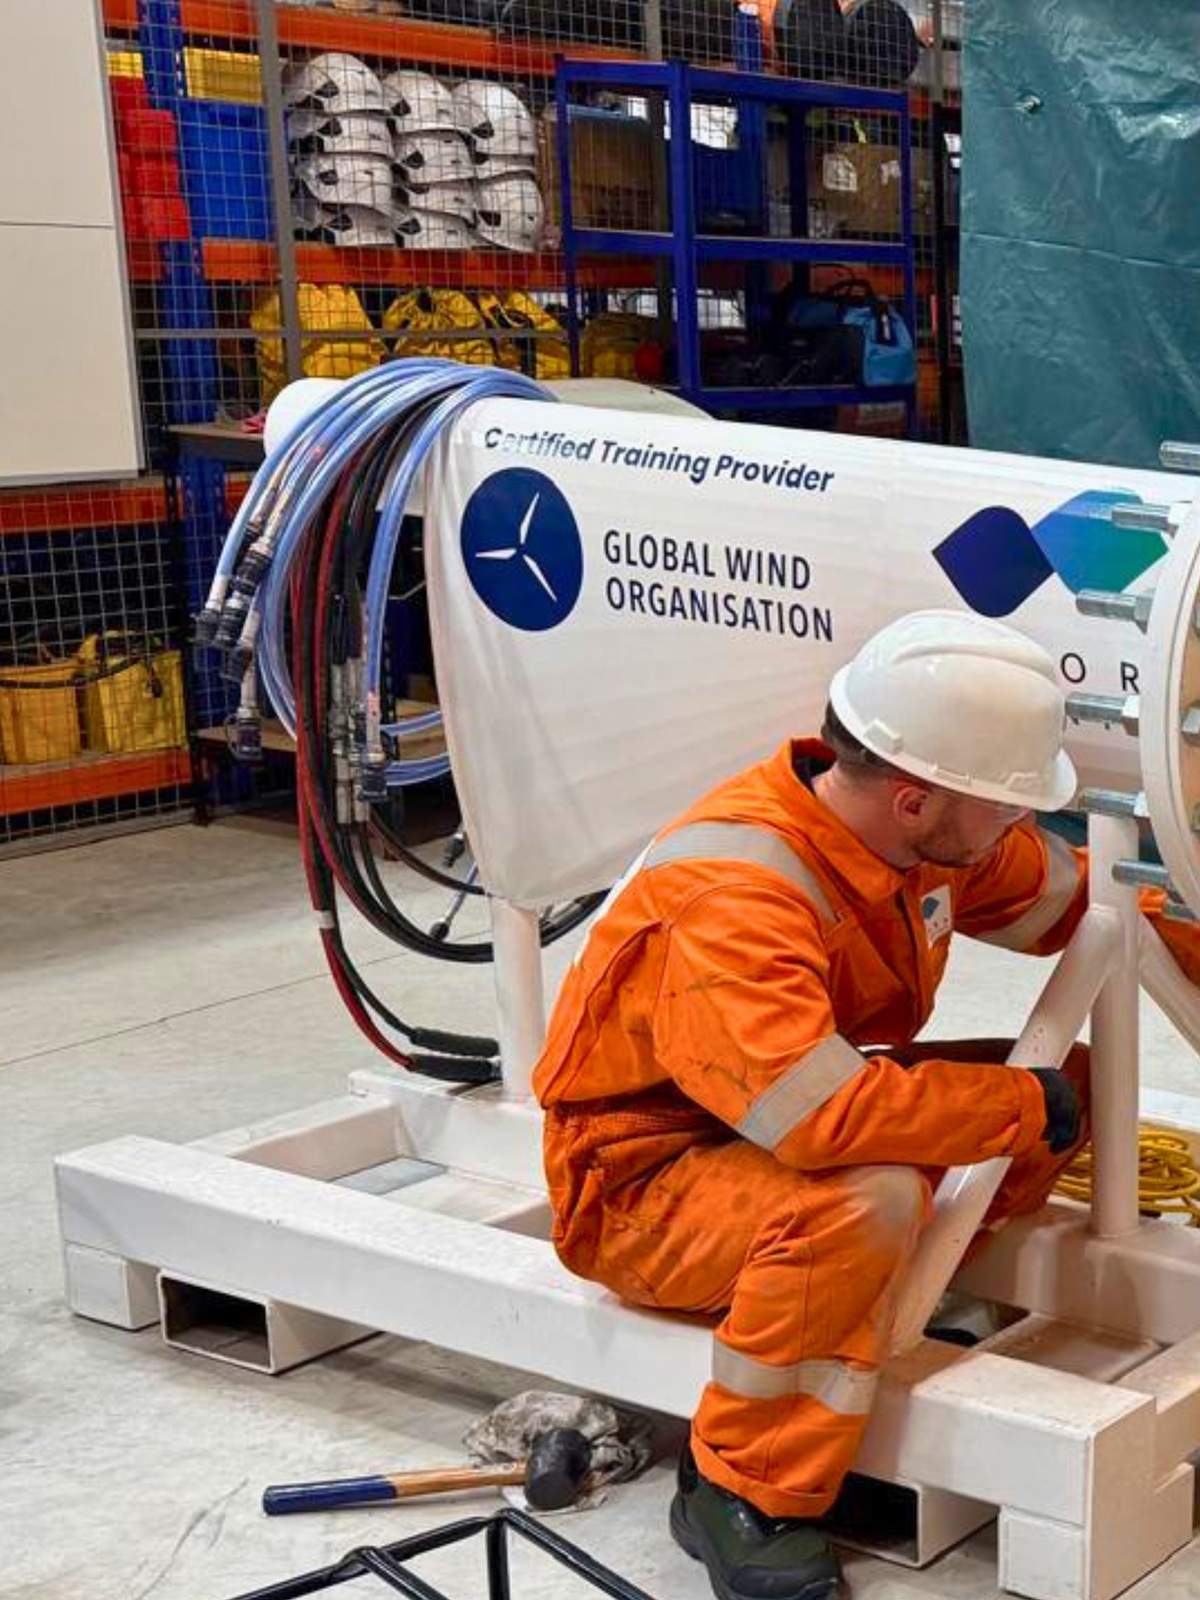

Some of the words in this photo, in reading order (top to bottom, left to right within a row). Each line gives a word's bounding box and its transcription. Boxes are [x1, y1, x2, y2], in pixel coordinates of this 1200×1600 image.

[484, 427, 597, 460] Certified
[601, 440, 711, 485] Training
[713, 455, 835, 493] Provider
[603, 529, 716, 578] GLOBAL
[724, 545, 811, 590] WIND
[606, 576, 834, 643] ORGANISATION
